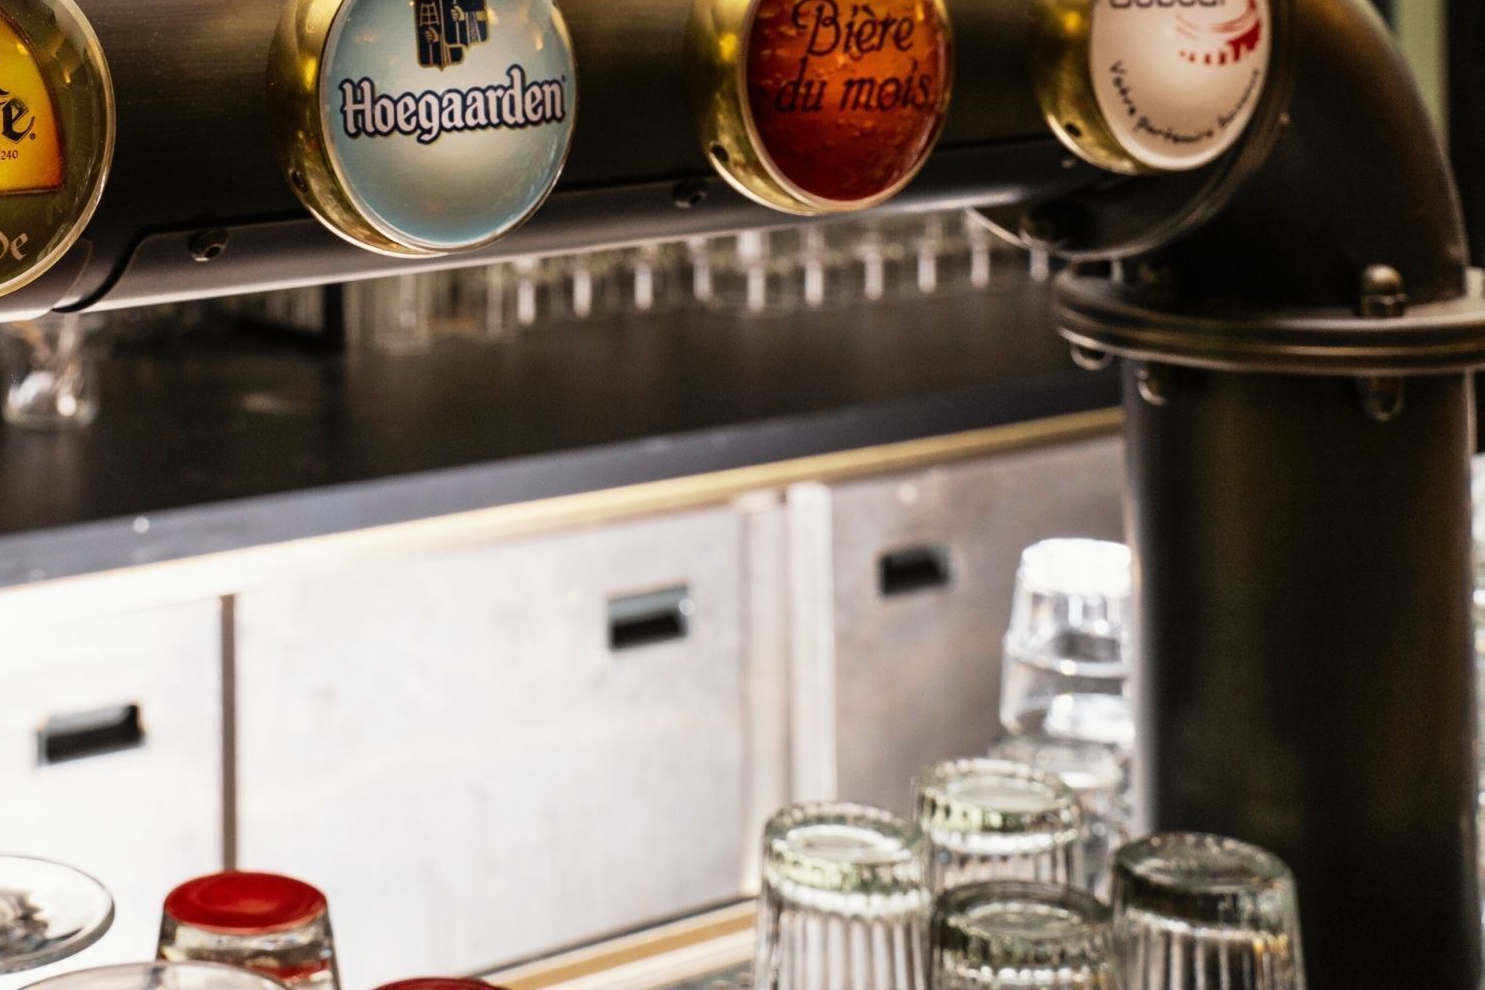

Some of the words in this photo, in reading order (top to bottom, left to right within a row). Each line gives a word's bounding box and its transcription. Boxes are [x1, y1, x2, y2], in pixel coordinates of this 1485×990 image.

[340, 64, 566, 144] Hoegaarden
[775, 56, 827, 113] du
[840, 60, 930, 111] mois
